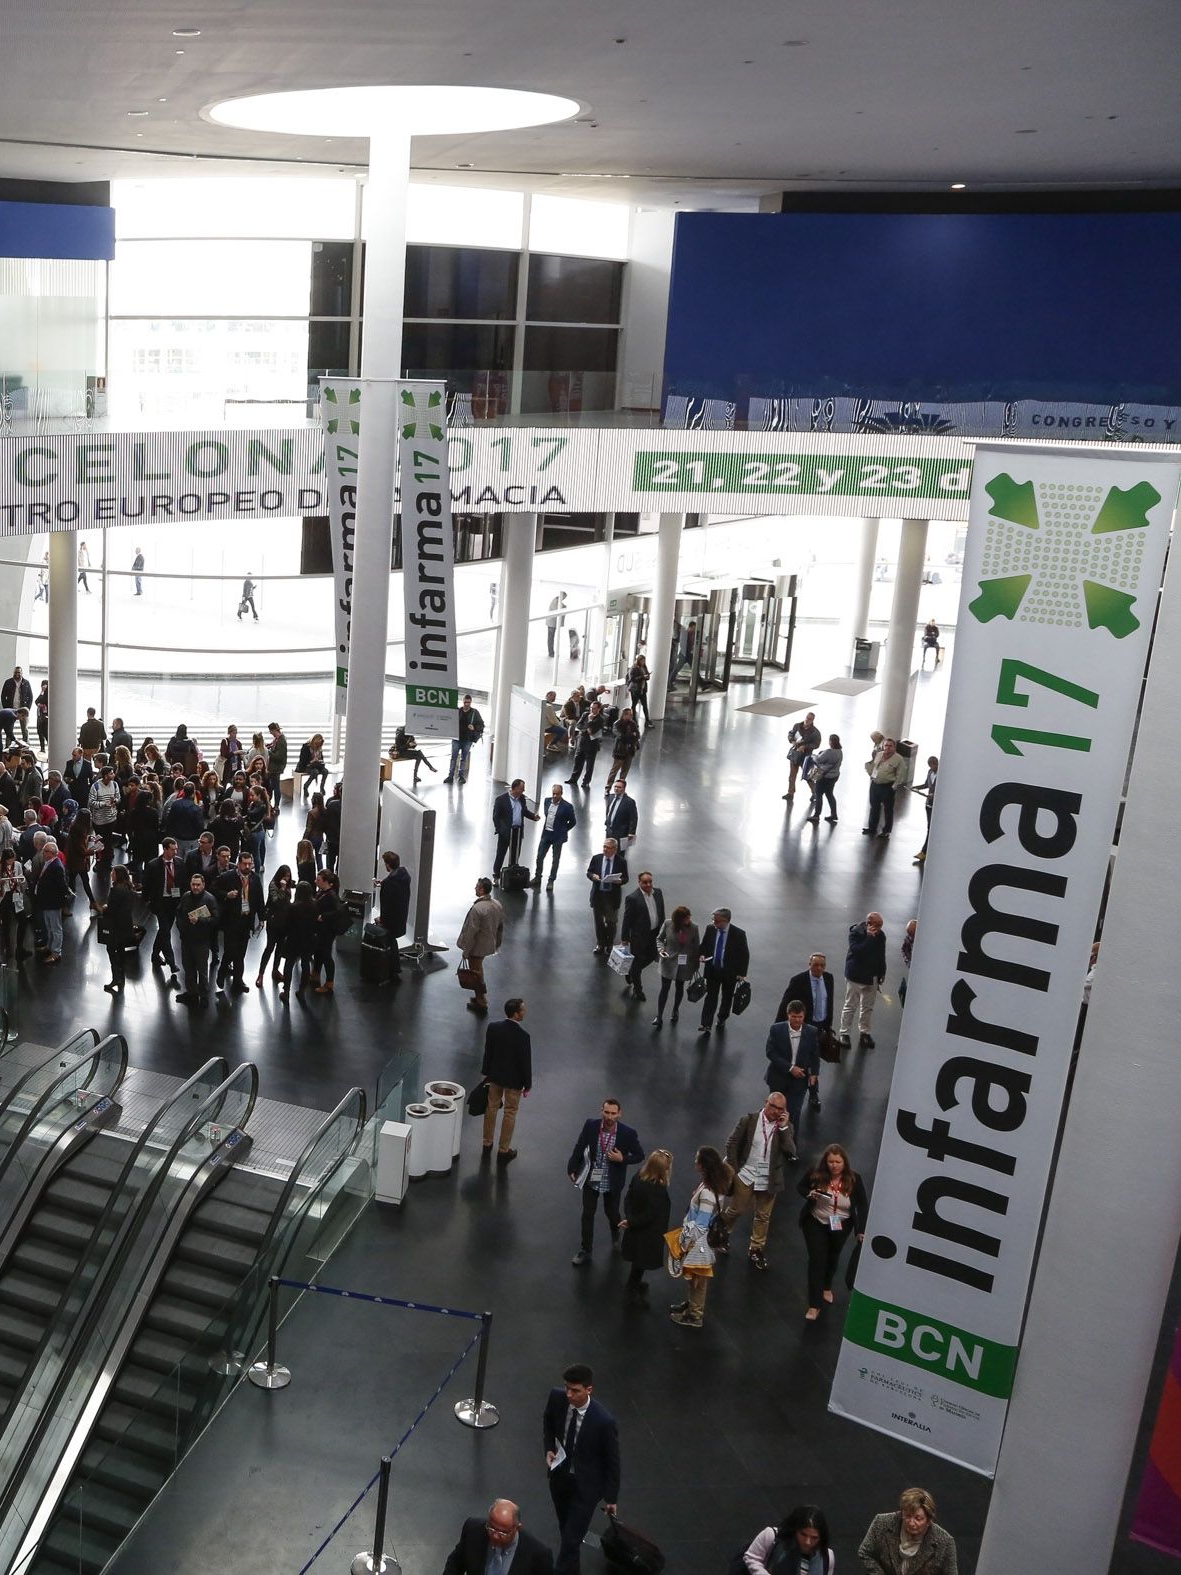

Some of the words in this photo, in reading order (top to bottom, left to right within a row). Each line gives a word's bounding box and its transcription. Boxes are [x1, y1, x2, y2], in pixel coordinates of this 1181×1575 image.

[448, 436, 569, 473] 017
[652, 458, 725, 489] 21,
[741, 461, 801, 487] 22
[815, 468, 845, 493] y
[859, 464, 921, 490] 23
[94, 489, 283, 521] EUROPEO
[298, 488, 329, 510] D
[409, 450, 449, 672] infarma17
[415, 688, 450, 705] BCN
[871, 658, 1100, 1294] infarma17
[874, 1309, 984, 1381] BCN
